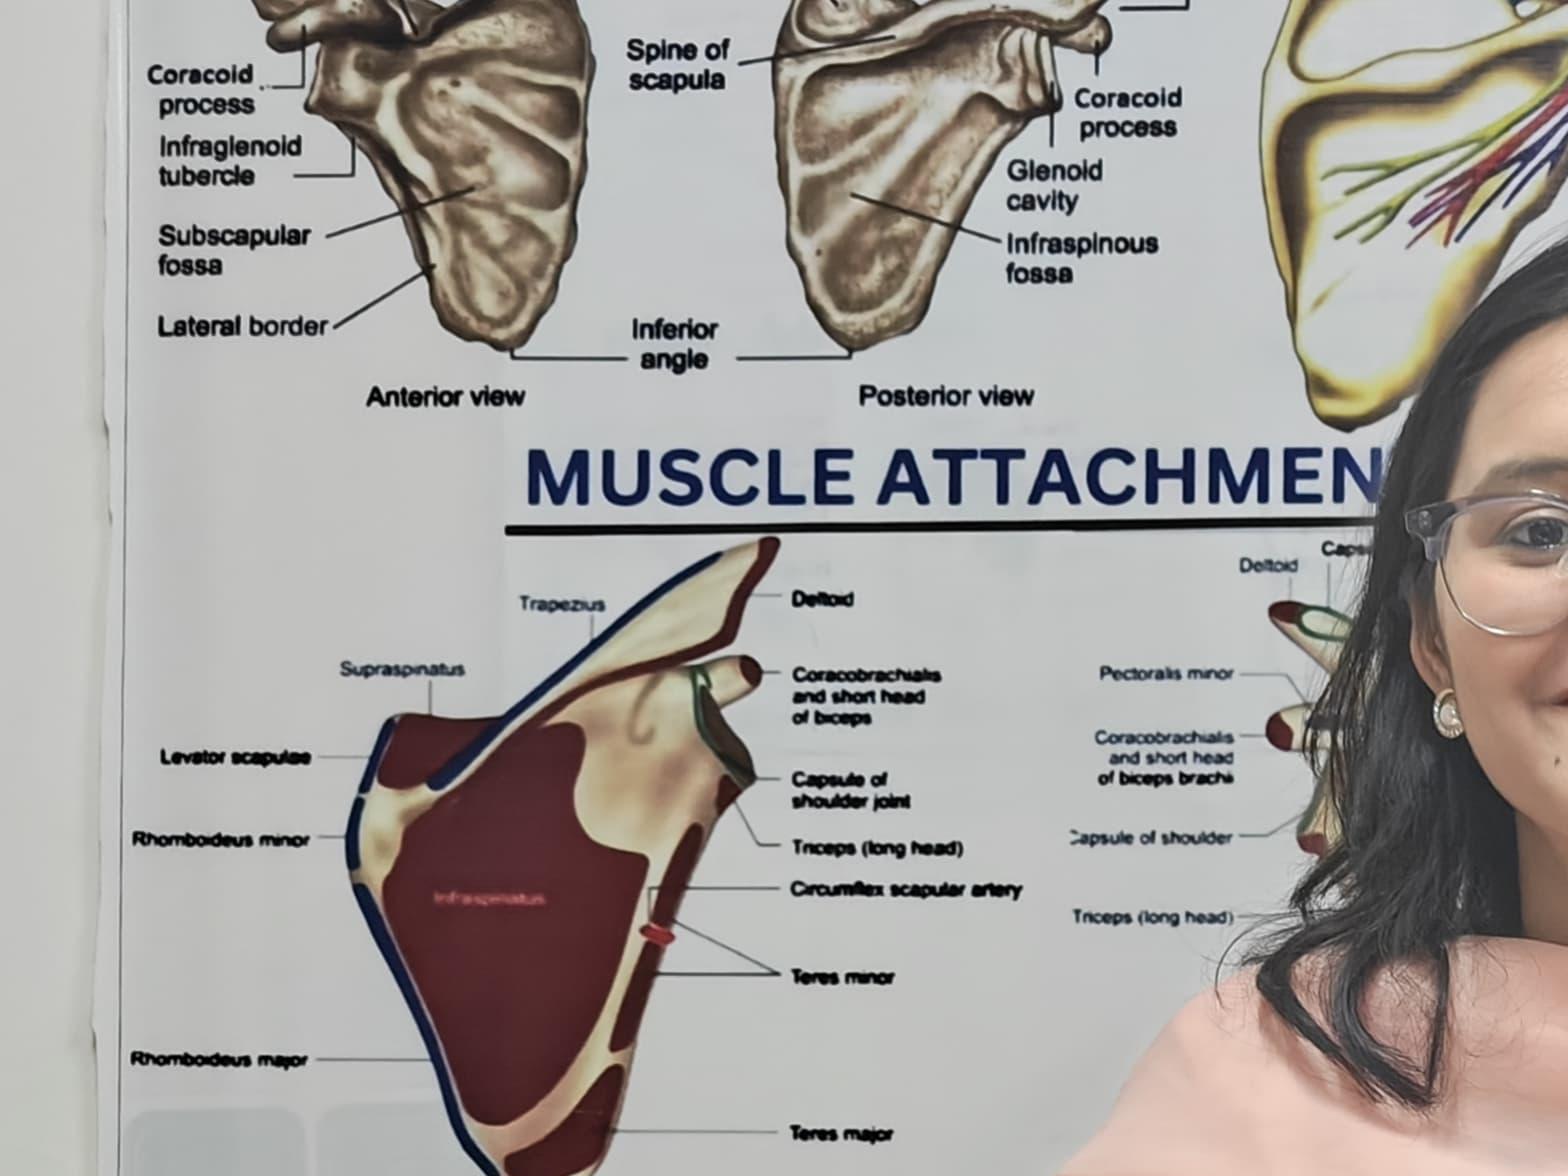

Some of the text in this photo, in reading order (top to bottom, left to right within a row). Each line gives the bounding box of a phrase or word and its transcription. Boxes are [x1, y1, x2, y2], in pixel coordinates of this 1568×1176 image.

[627, 38, 730, 64] Spine of
[148, 64, 253, 84] Coracoid
[630, 69, 725, 94] scapula
[1075, 87, 1182, 108] Coracoid
[160, 98, 254, 118] process
[1081, 120, 1177, 141] process
[161, 135, 301, 162] Infraglenoid
[160, 165, 254, 186] tubercle
[1008, 160, 1102, 181] Glenoid
[1007, 190, 1078, 216] cavity
[159, 225, 311, 250] Subscapular
[1008, 232, 1158, 258] Infraspinous
[159, 254, 222, 275] fossa
[1007, 263, 1072, 283] fossa
[159, 316, 328, 337] Lateral border
[633, 318, 718, 339] Inferior
[641, 349, 708, 374] angle
[367, 386, 525, 407] Anterior view
[860, 385, 1034, 406] Posterior view
[528, 449, 854, 506] MUSCLE
[1240, 558, 1298, 573] Deltoid
[520, 595, 605, 613] Trapezius
[792, 590, 854, 607] Deltoid
[341, 661, 465, 678] Supraspinatus
[793, 667, 941, 682] Coracobrachialis
[1100, 666, 1233, 680] Pectoralis minor
[793, 690, 925, 704] and short head
[792, 710, 872, 728] of biceps
[1095, 730, 1234, 745] Coracobrachialis
[161, 749, 311, 768] Levator scapulae
[1110, 752, 1233, 765] and short head
[792, 771, 888, 789] Capsule of
[1098, 770, 1114, 785] of
[1120, 771, 1173, 787] biceps
[792, 794, 910, 811] shoulder joint
[133, 831, 310, 848] Rhomboideus minor
[1140, 830, 1156, 845] of
[1162, 832, 1232, 845] shoulder
[794, 839, 963, 859] Triceps (long head)
[791, 881, 883, 896] Circumflex
[890, 882, 965, 899] scapular
[1074, 909, 1233, 927] Triceps (long head)
[792, 969, 895, 985] Teres minor
[131, 1051, 252, 1067] Rhomboideus
[790, 1125, 894, 1145] Teres major
